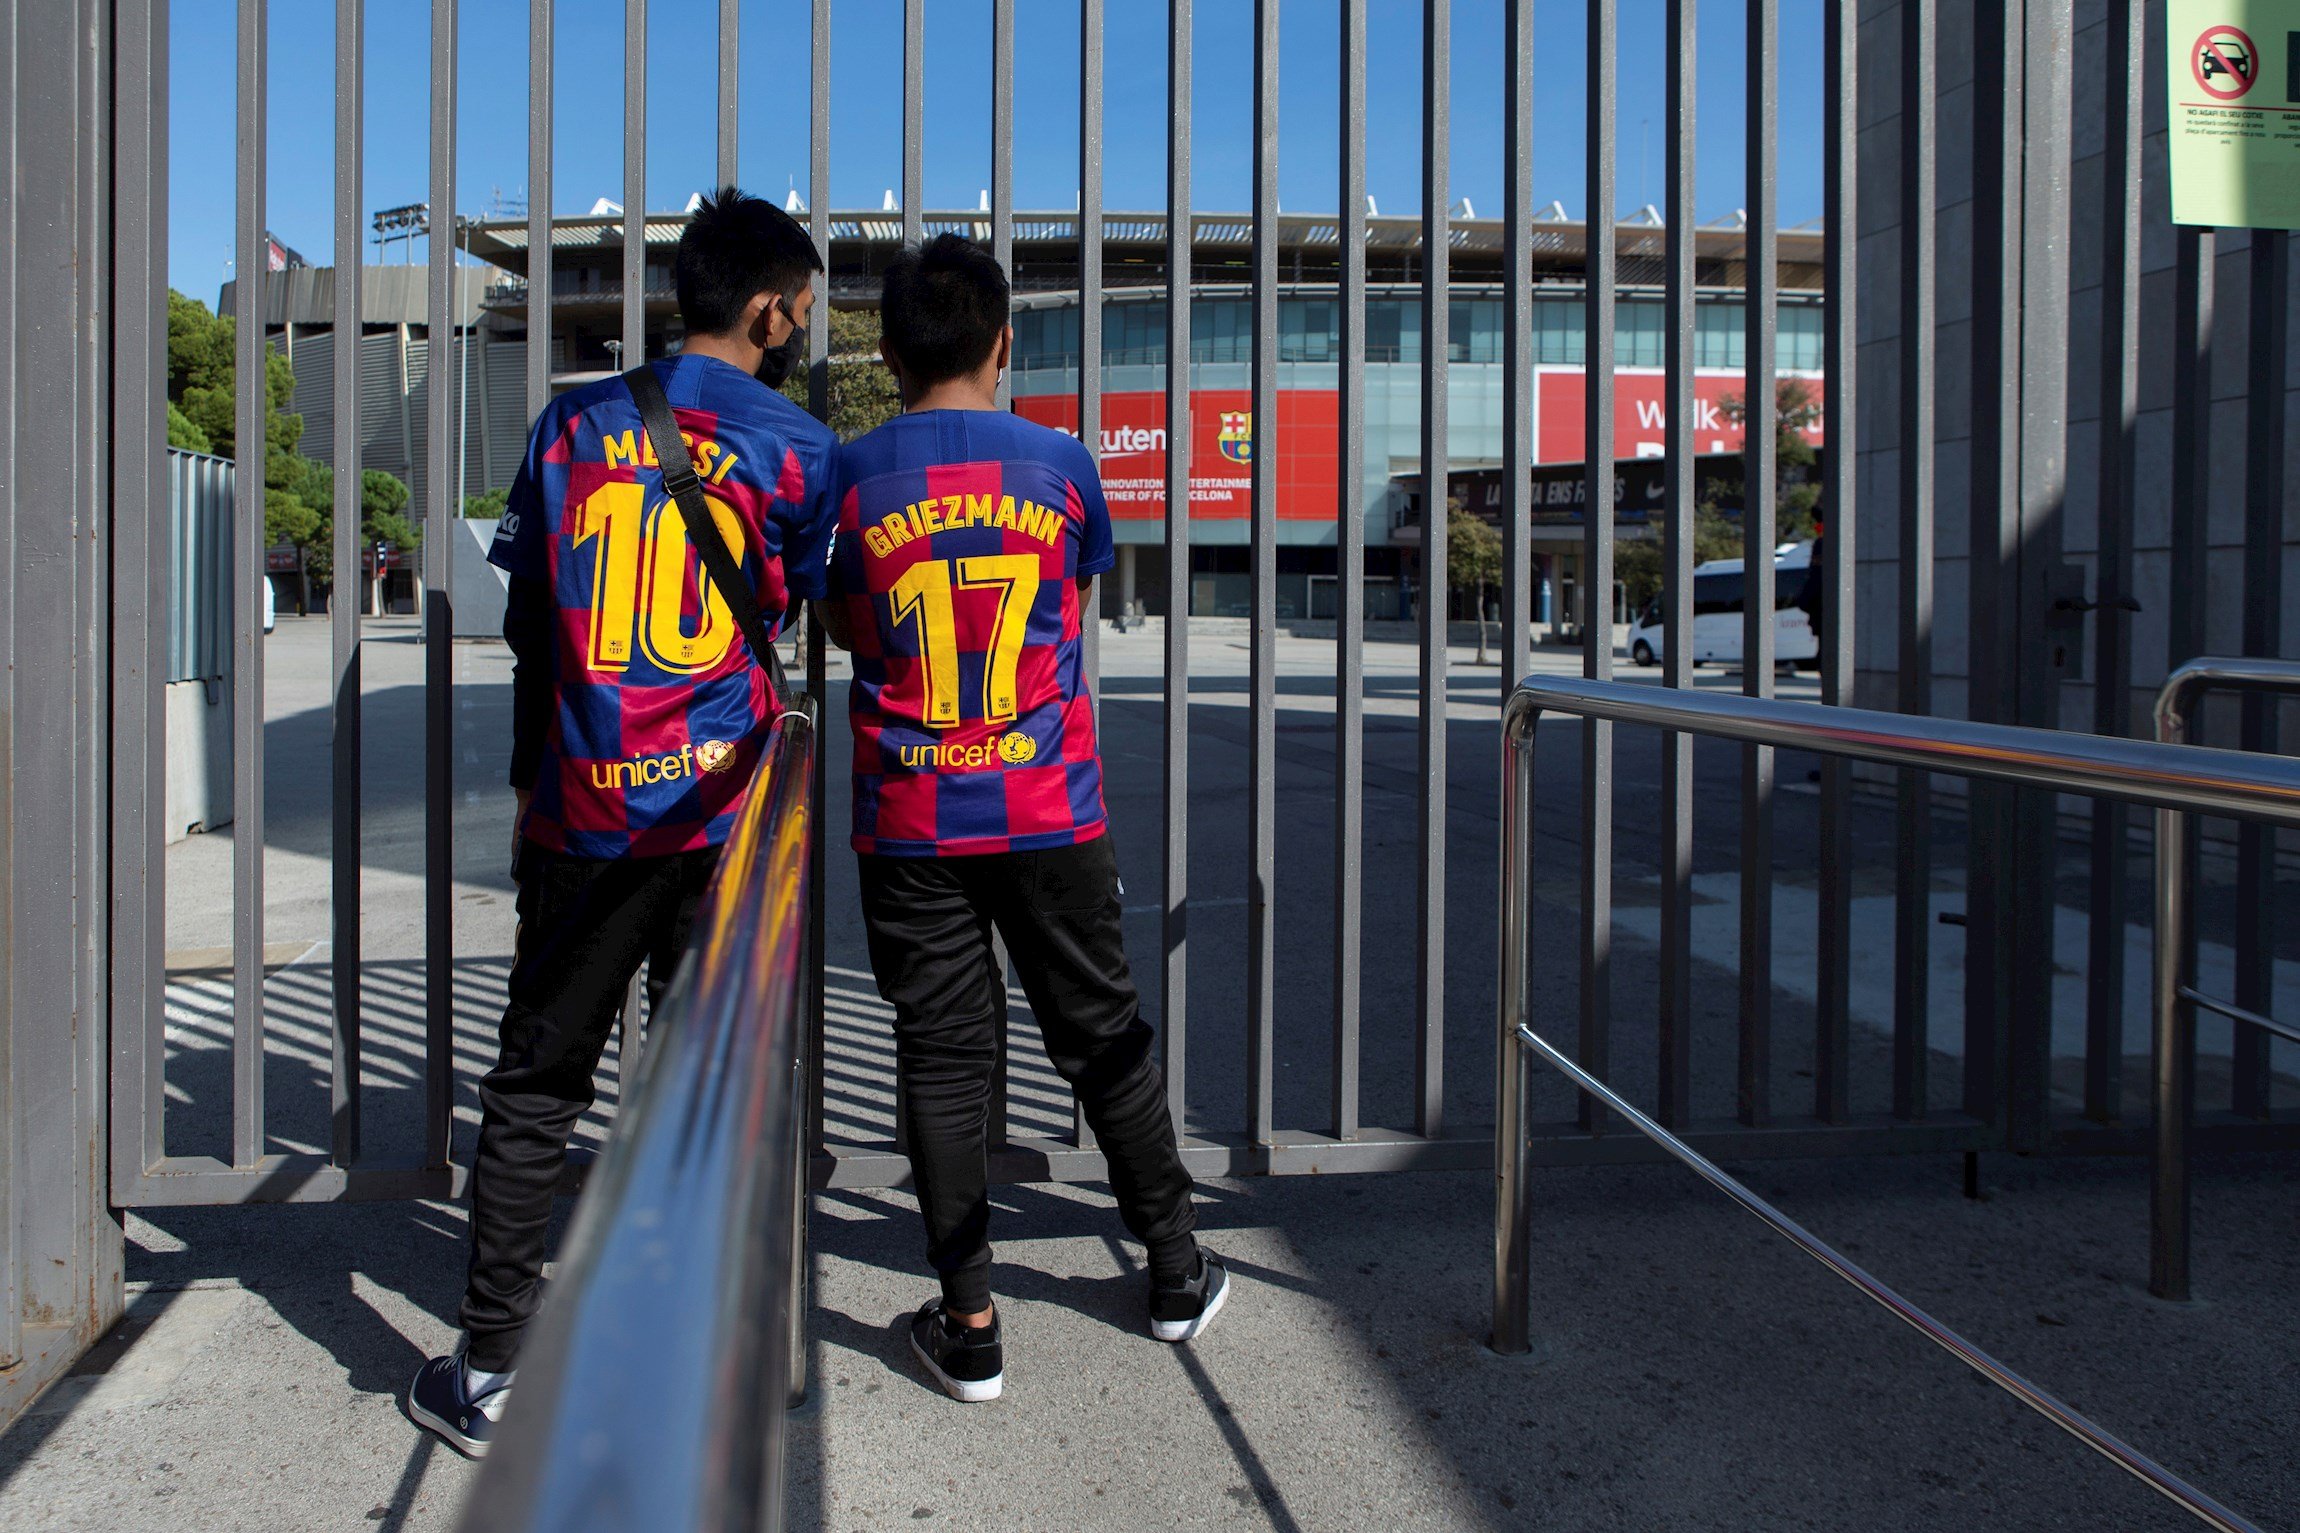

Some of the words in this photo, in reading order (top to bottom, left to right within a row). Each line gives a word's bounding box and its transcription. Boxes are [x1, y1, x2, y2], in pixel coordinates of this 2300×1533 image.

[1636, 398, 1721, 431] Wlk
[1139, 490, 1151, 502] OF
[865, 494, 1065, 558] GRIEZMANN
[573, 482, 746, 674] 10
[888, 553, 1040, 728] 17
[591, 743, 693, 789] unicef
[900, 736, 995, 767] unicef
